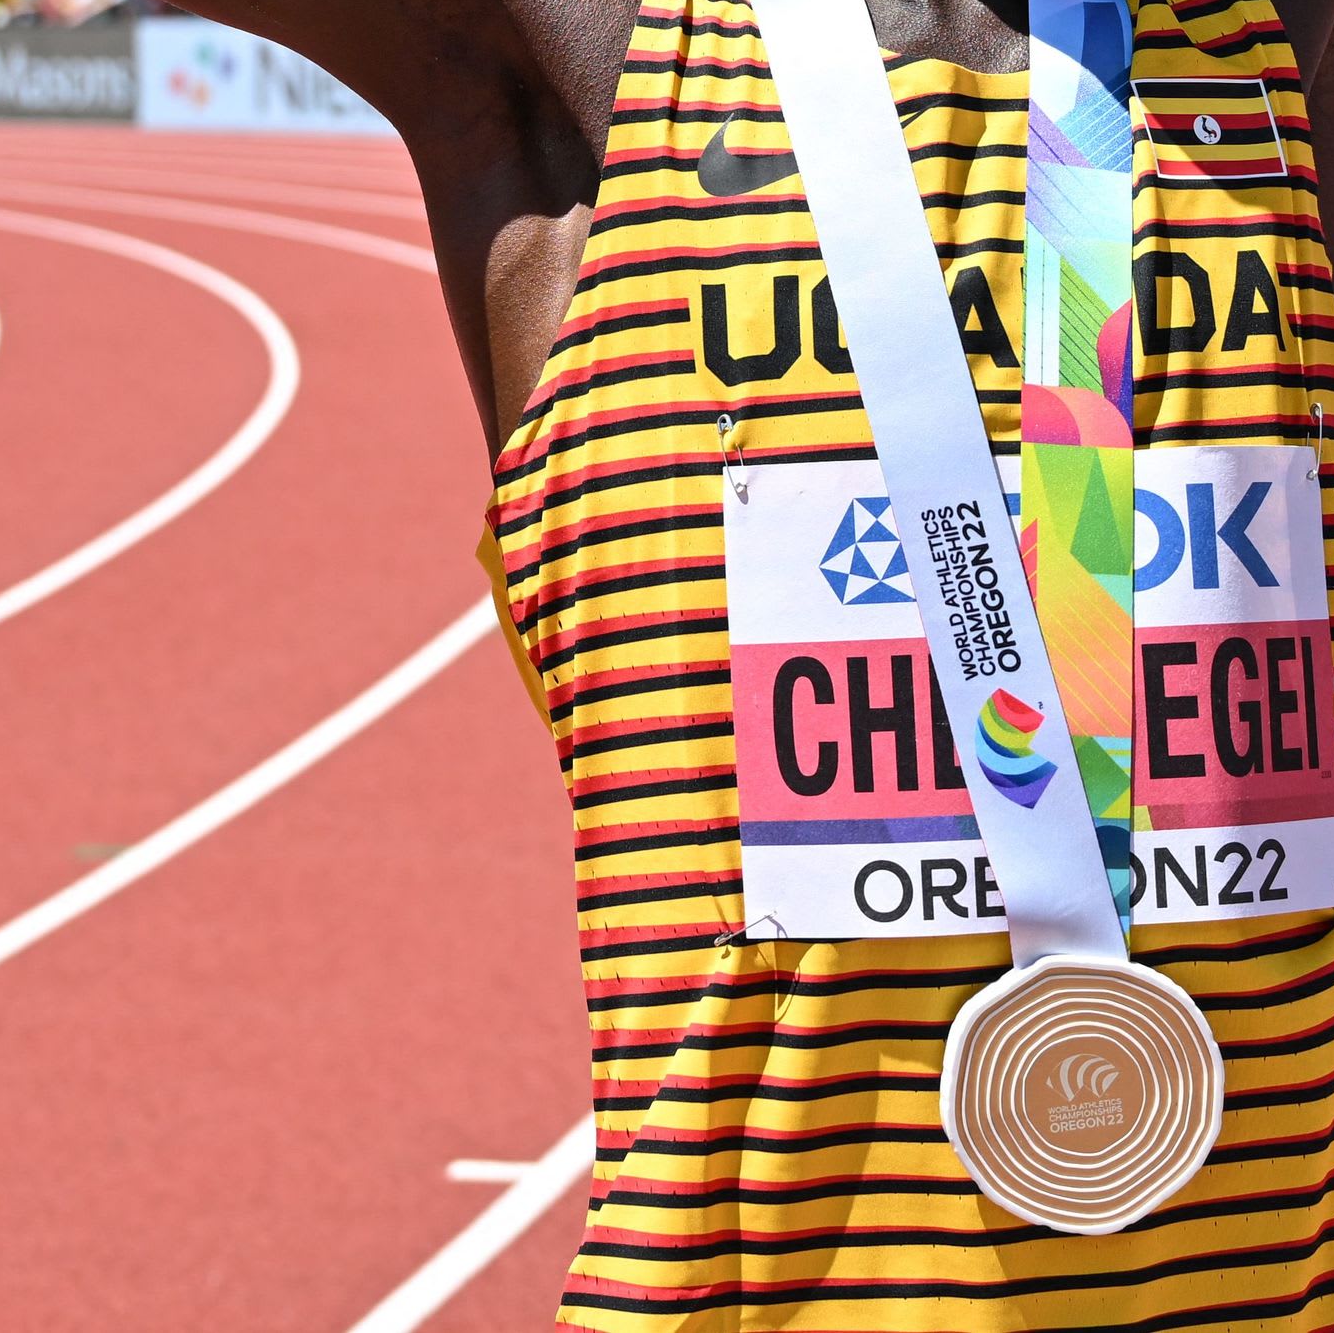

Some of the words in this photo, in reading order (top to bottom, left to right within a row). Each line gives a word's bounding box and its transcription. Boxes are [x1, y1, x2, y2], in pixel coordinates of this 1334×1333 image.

[921, 509, 960, 608] ATHLETICS
[937, 505, 997, 676] CHAMPIONSHIPS
[949, 613, 979, 681] WORLD
[1049, 1104, 1077, 1114] WORLD
[1078, 1098, 1122, 1110] ATHLETICS
[1049, 1106, 1123, 1122] CHAMPIONSHIPS
